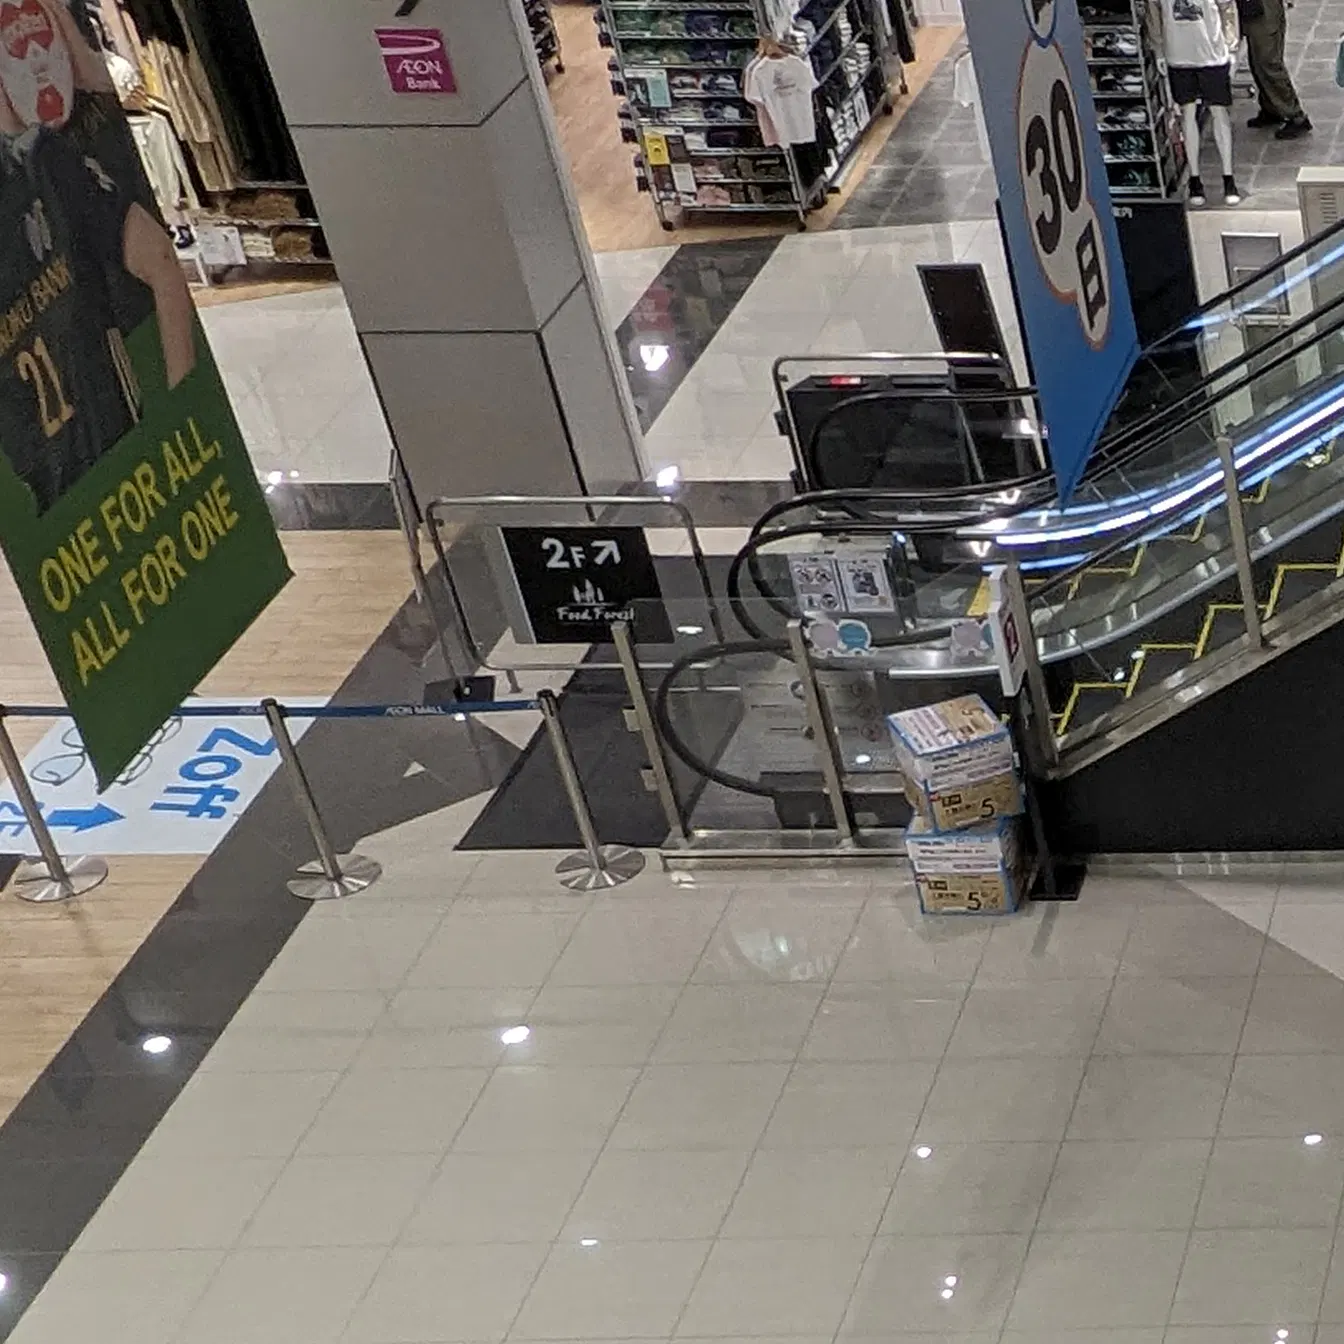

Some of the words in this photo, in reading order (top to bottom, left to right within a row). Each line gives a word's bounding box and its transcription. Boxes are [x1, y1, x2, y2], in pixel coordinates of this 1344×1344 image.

[406, 76, 442, 90] Bank
[16, 334, 76, 439] 21
[40, 517, 110, 613] ONE
[99, 461, 167, 553] FOR
[161, 416, 223, 497] ALL,
[541, 537, 587, 569] 2F
[71, 600, 131, 688] ALL
[120, 534, 188, 626] FOR
[180, 473, 240, 561] ONE
[556, 606, 592, 621] Food
[594, 606, 635, 621] Forest
[149, 727, 279, 819] Zoff
